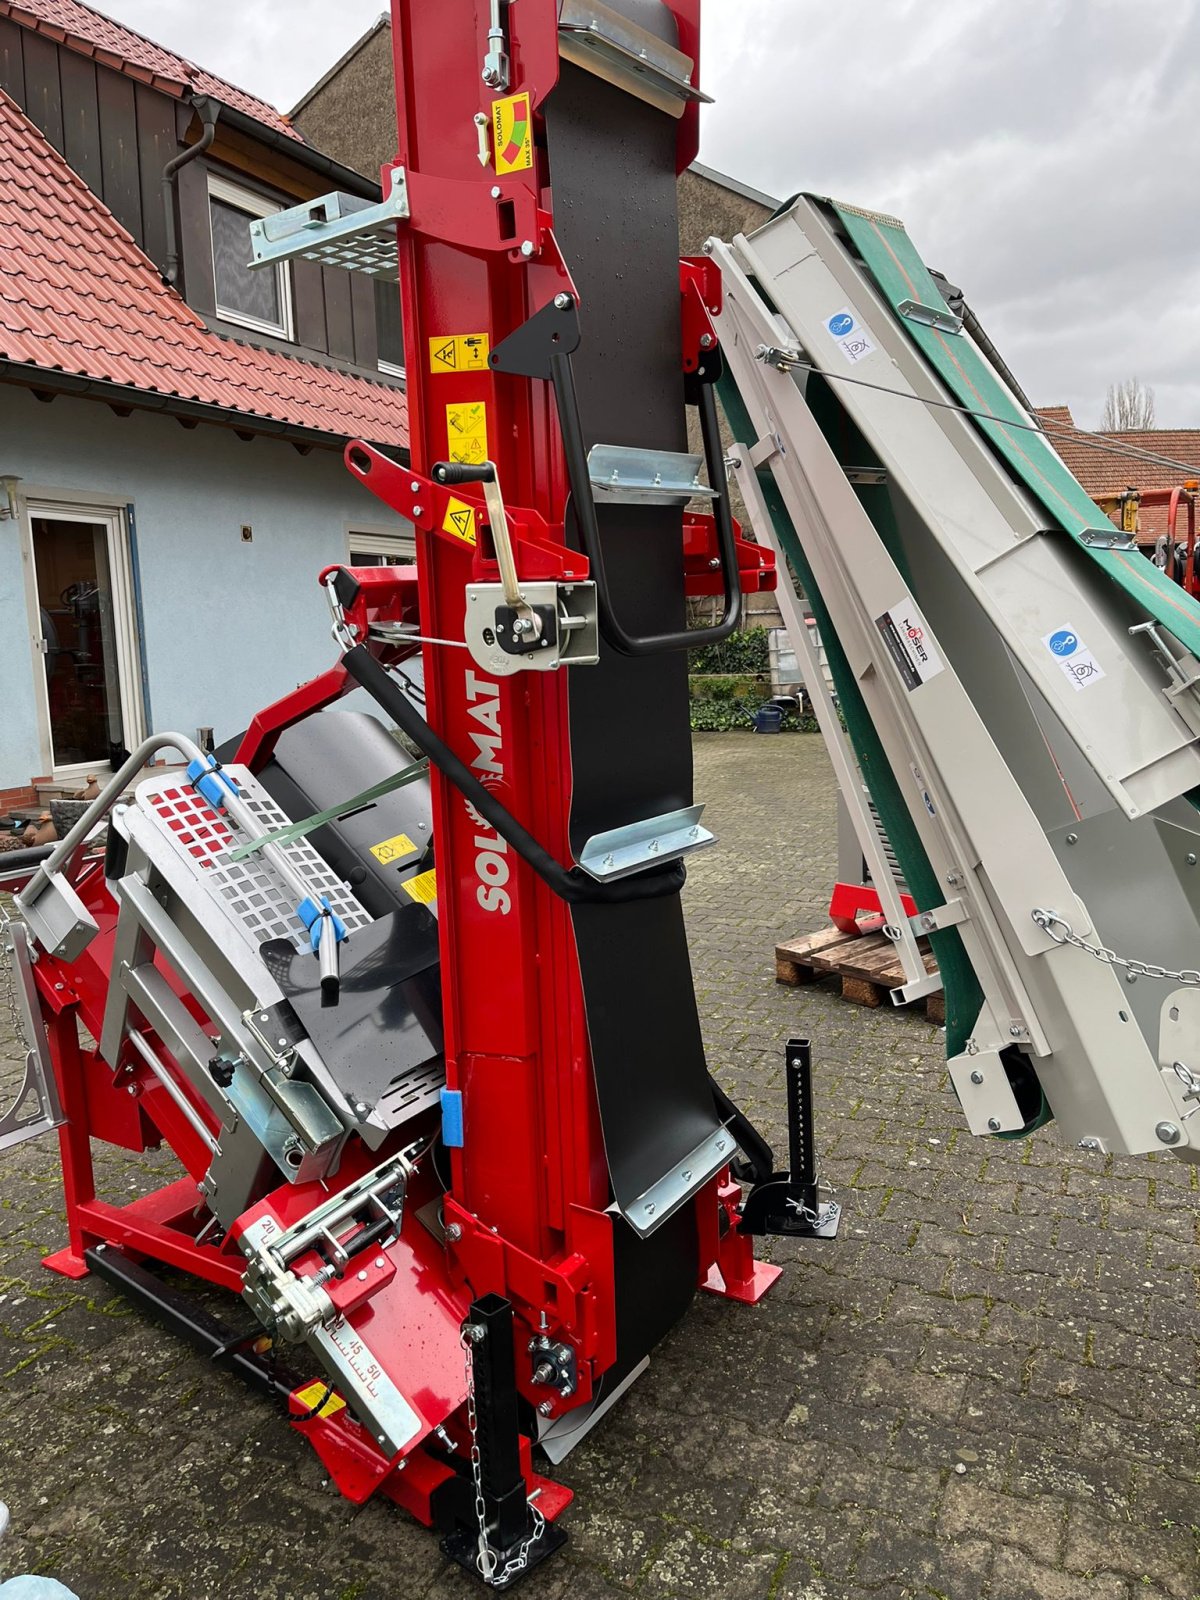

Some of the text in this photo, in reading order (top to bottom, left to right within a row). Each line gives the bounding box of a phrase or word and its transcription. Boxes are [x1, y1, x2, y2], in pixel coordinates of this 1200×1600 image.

[495, 106, 503, 147] SOLOMAT
[898, 622, 922, 666] LANDMASCHINEN
[902, 618, 928, 662] MOSER
[261, 1219, 276, 1235] 20
[349, 1340, 363, 1355] 45
[366, 1364, 381, 1380] 50
